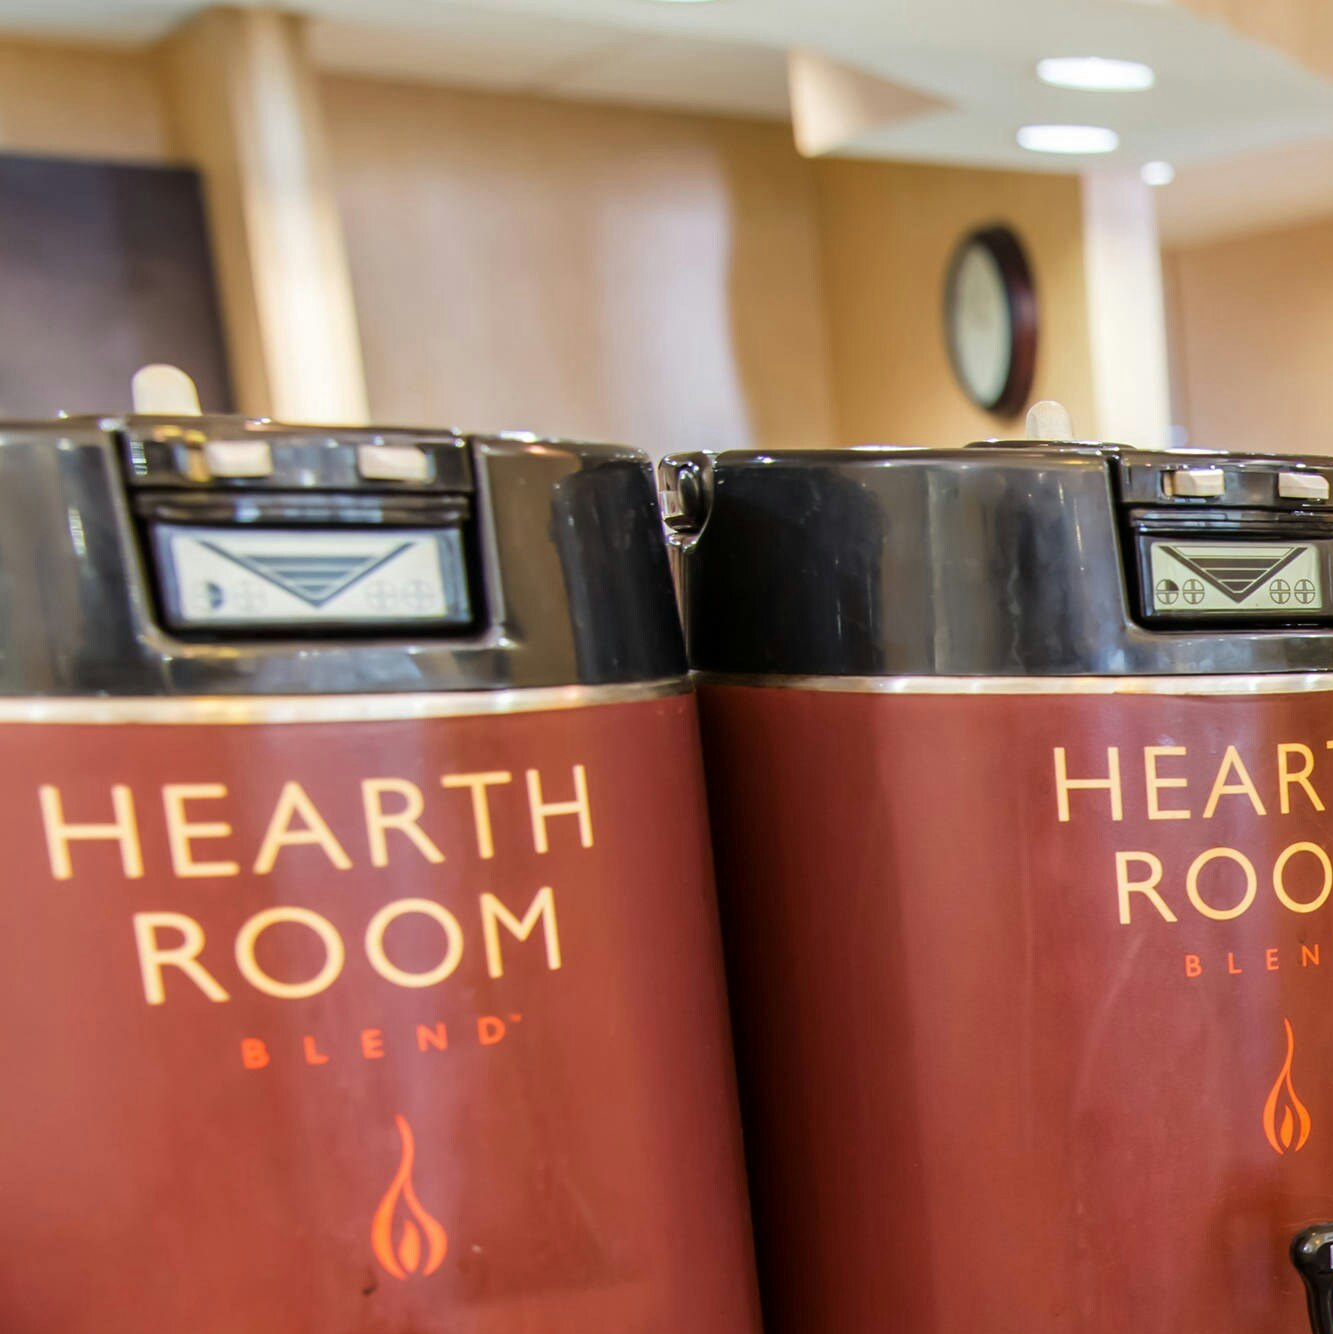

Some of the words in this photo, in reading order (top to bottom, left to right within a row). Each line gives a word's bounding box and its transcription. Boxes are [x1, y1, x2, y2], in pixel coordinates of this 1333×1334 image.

[37, 764, 596, 881] HEARTH
[132, 886, 562, 1006] ROOM
[241, 1014, 507, 1070] BLEND
